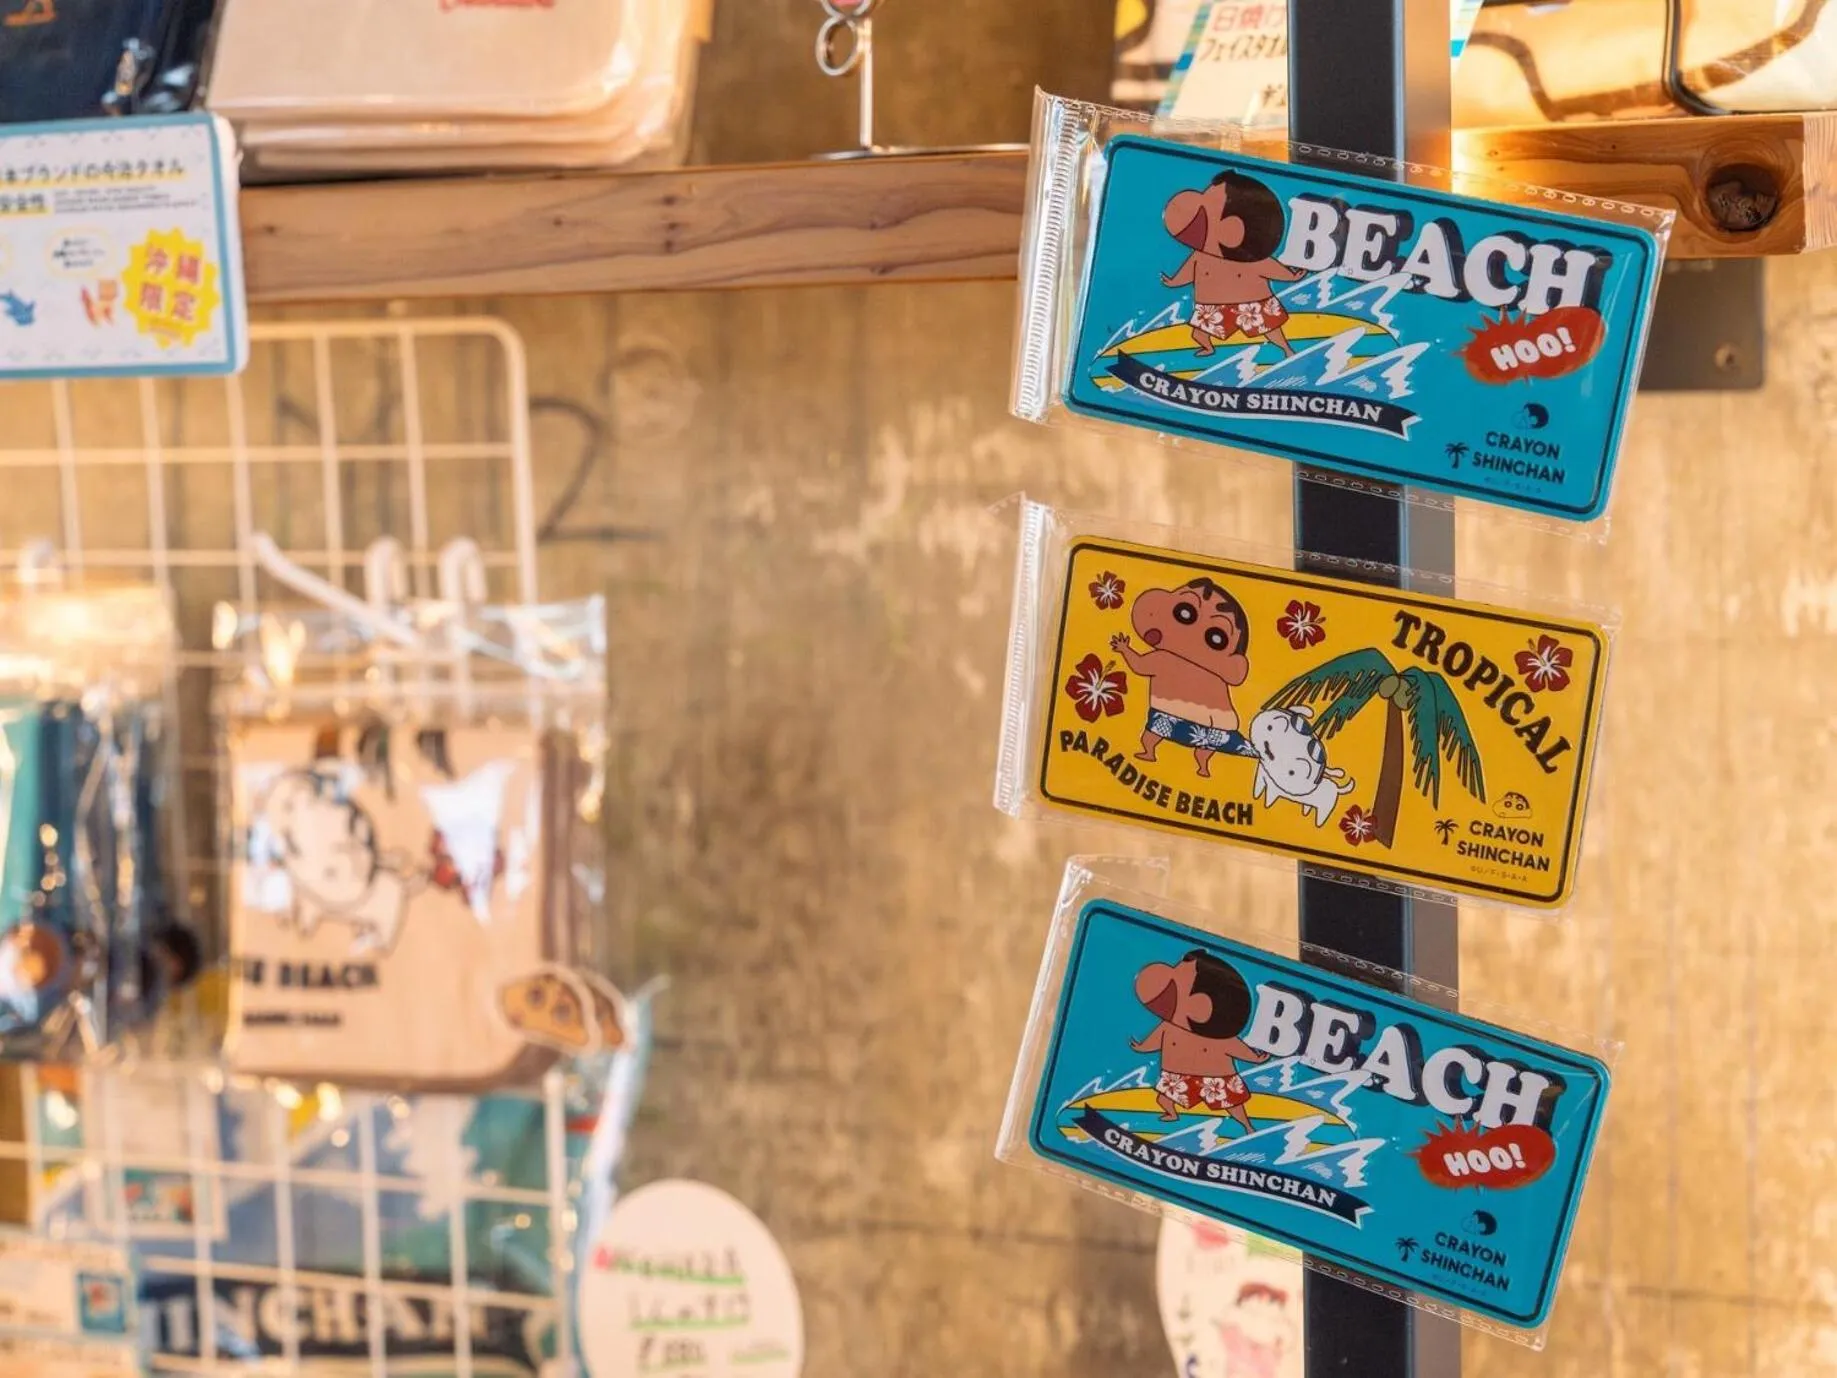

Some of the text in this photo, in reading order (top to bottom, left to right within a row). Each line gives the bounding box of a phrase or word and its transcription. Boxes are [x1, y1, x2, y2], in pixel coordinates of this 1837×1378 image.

[1280, 194, 1604, 315] BEACH
[1490, 326, 1577, 371] HOO!
[1139, 371, 1382, 423] CRAYON SHINCHAN
[1485, 430, 1560, 460] CRAYON
[1471, 451, 1566, 485] SHINCHAN
[1391, 609, 1571, 775] TROPICAL
[1059, 729, 1254, 825] PARADISE BEACH
[1469, 820, 1544, 847] CRAYON
[1456, 840, 1550, 872] SHINCHAN
[1244, 982, 1558, 1129] BEACH
[1104, 1129, 1337, 1207] CRAYON SHINCHAN
[1443, 1143, 1527, 1178] HOO!
[1420, 1248, 1511, 1292] SHINCHAN
[1434, 1231, 1508, 1267] CRAYON
